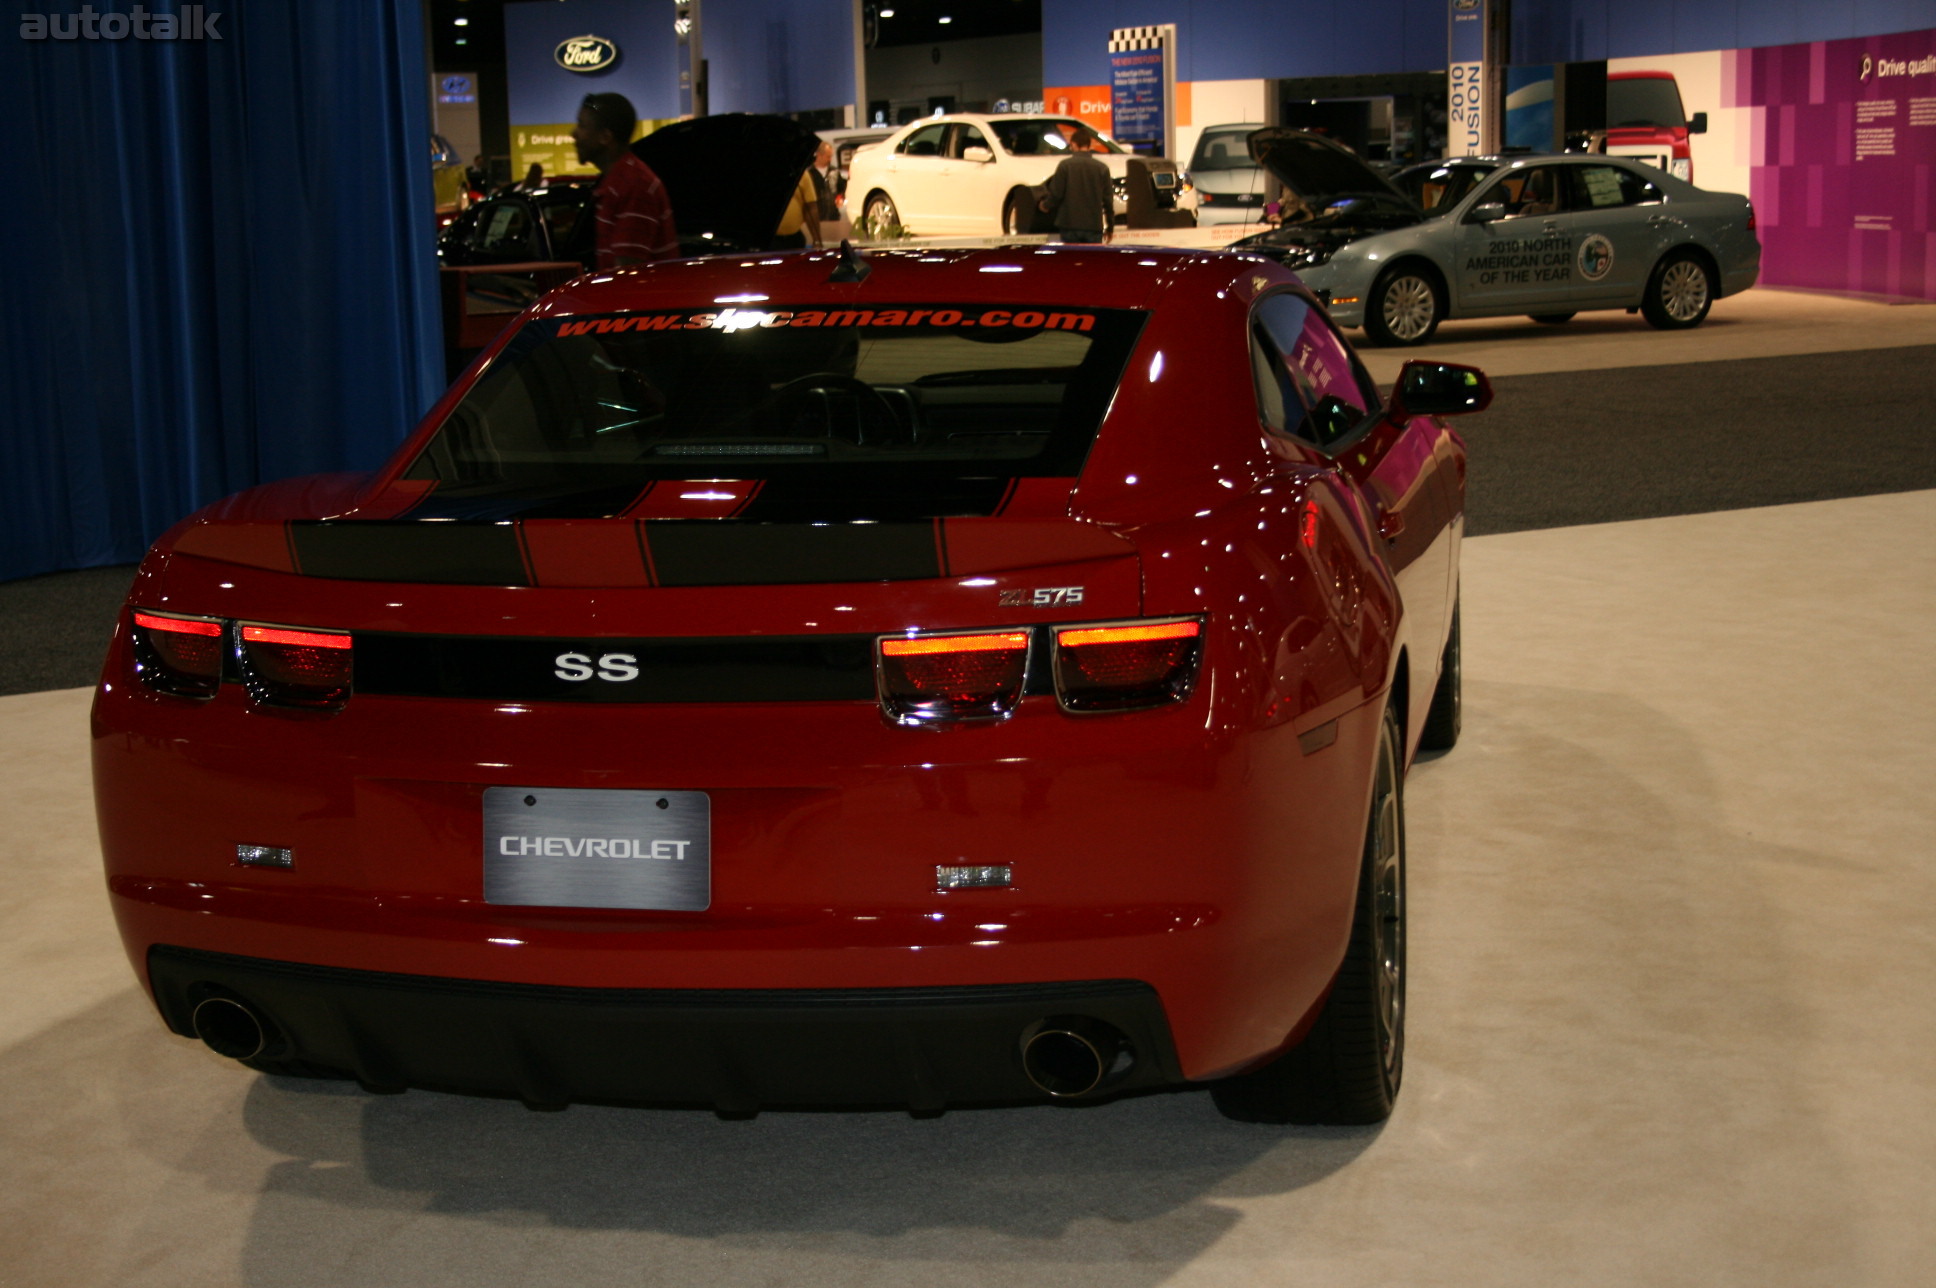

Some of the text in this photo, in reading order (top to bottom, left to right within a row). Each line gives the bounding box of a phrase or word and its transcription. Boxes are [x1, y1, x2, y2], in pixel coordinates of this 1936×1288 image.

[564, 41, 602, 65] Ford
[1877, 58, 1906, 77] Drive
[1451, 66, 1465, 122] 2010
[1080, 101, 1111, 114] Driv
[531, 135, 576, 146] Drive gree
[1489, 238, 1571, 254] 2010 NORTH
[1466, 252, 1570, 270] AMERICAN CAR
[1480, 267, 1570, 284] OF THE YEAR
[554, 652, 639, 681] SS
[499, 836, 691, 861] CHEVROLET
